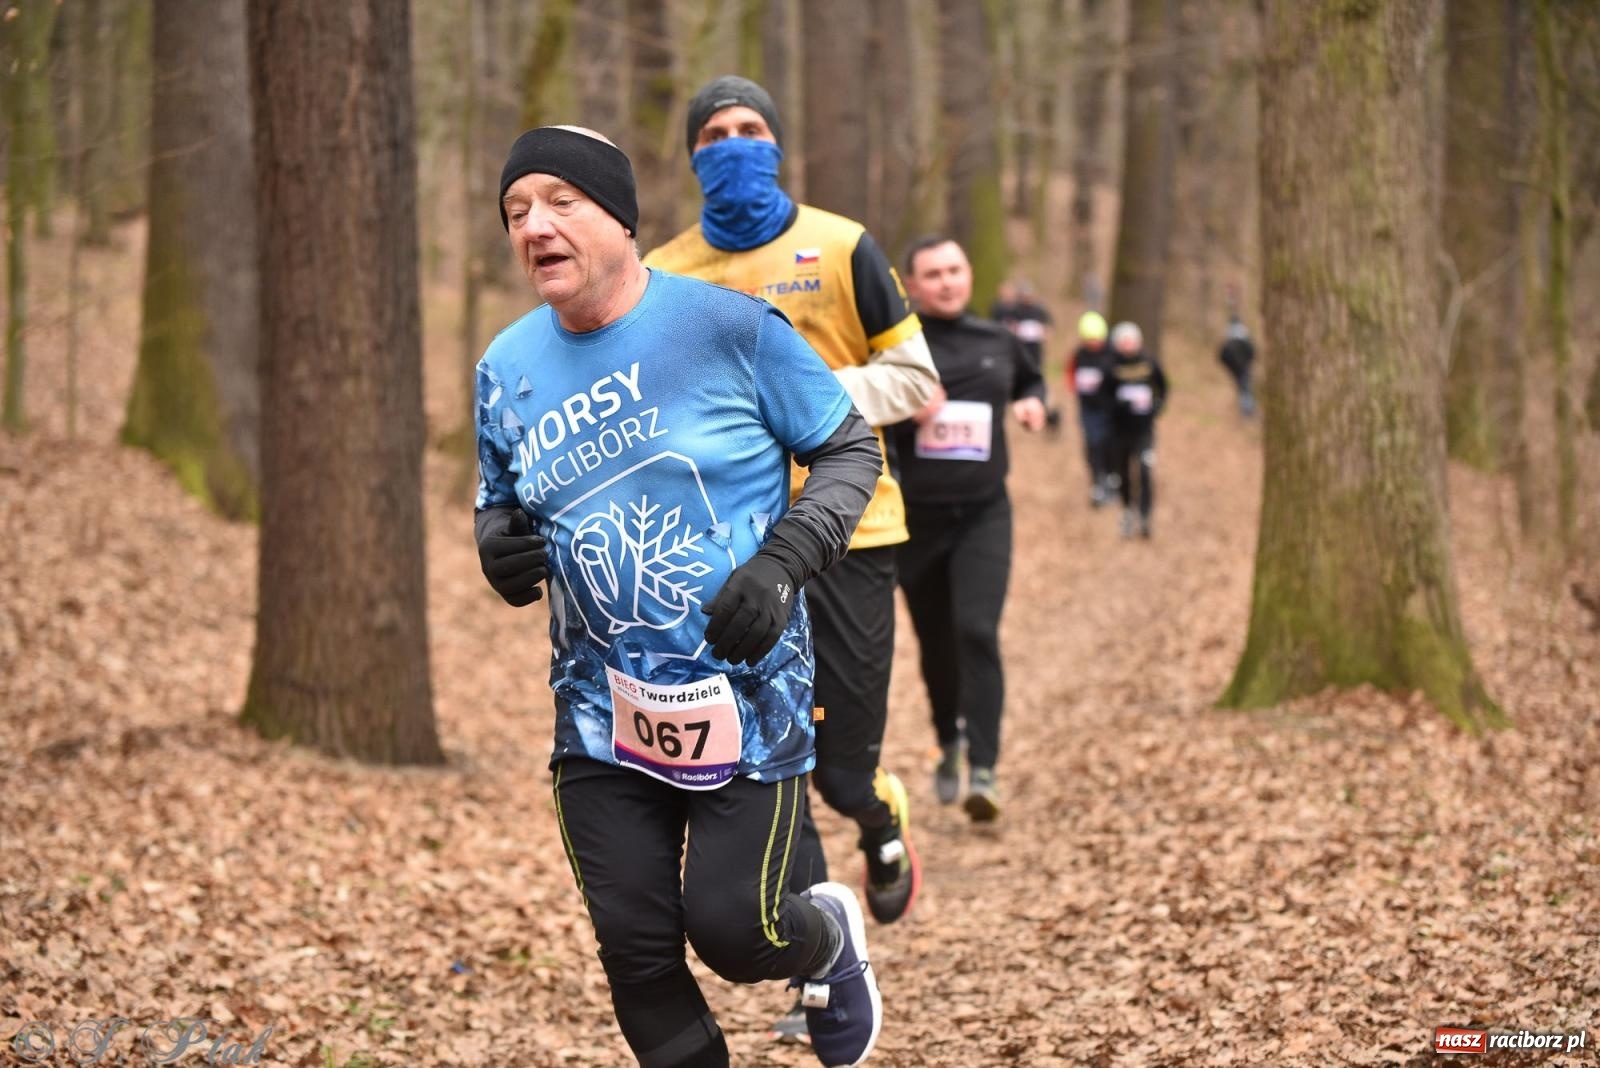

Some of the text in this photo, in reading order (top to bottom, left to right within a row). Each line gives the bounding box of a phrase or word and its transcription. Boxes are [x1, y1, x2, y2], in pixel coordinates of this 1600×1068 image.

[518, 362, 643, 477] MORSY
[522, 407, 669, 510] RACIBÓRZ
[614, 675, 637, 694] BIEG
[640, 685, 721, 703] Twardziela
[633, 711, 710, 760] 067
[682, 771, 717, 781] Racibórz
